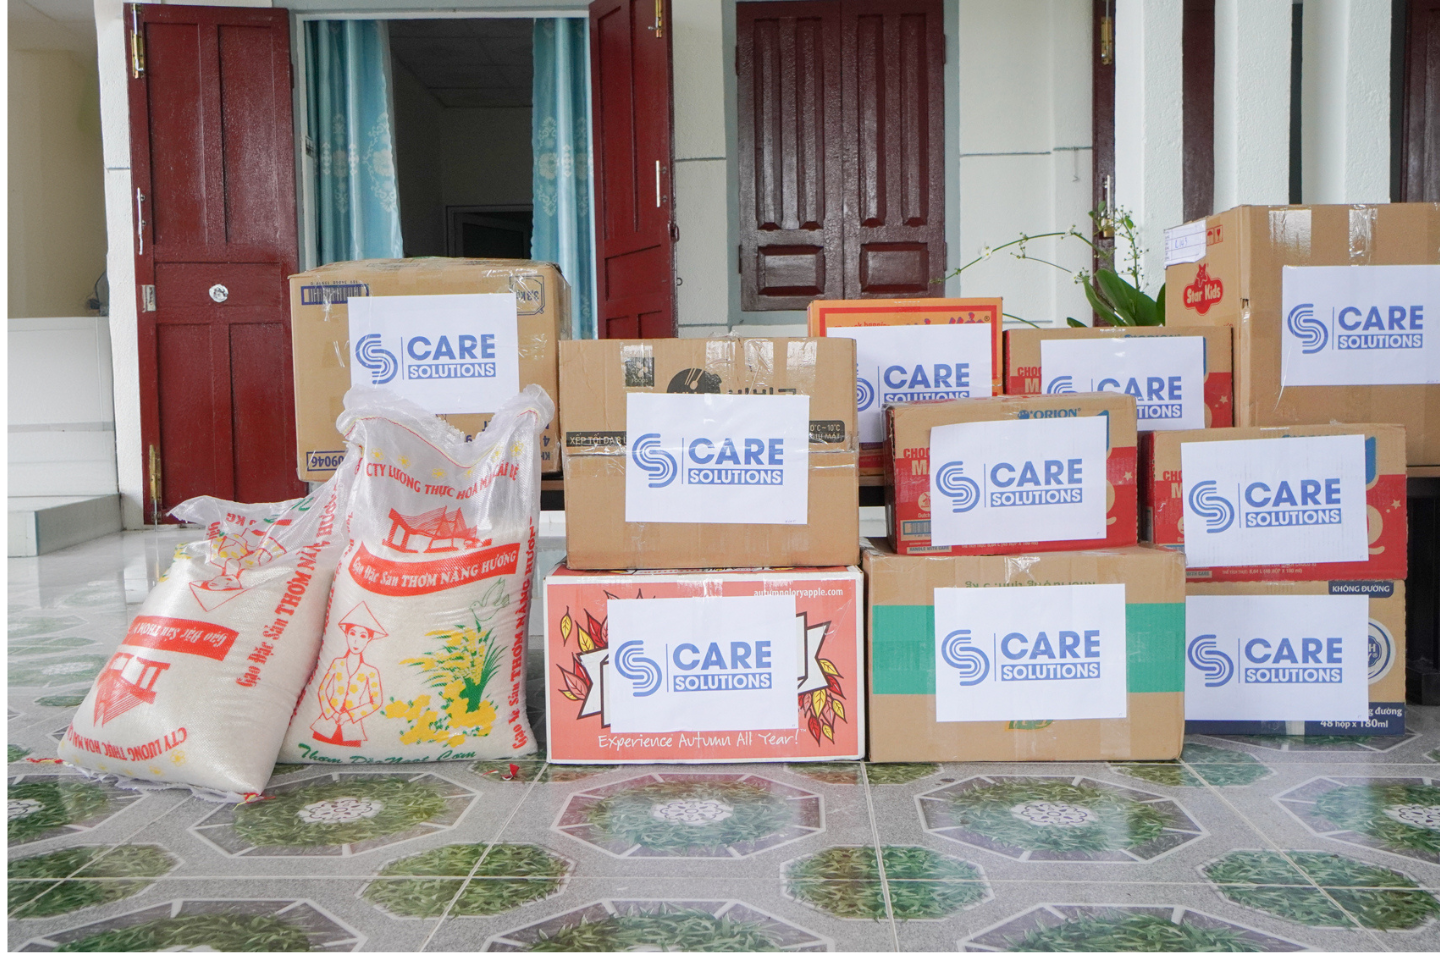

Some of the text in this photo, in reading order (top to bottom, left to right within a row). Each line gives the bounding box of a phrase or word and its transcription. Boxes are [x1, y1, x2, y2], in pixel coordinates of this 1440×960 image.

[1186, 285, 1221, 303] Star Kids
[1338, 305, 1424, 331] CARE
[407, 334, 496, 361] CARE
[1339, 334, 1423, 349] SOLUTIONS
[408, 363, 496, 380] SOLUTIONS
[883, 363, 970, 389] CARE
[885, 391, 969, 402] SOLUTIONS
[1097, 376, 1182, 401] CARE
[1034, 409, 1077, 419] ORION
[688, 438, 784, 465] CARE
[366, 462, 478, 499] CTY LƯƠNG THỰC HOA
[689, 469, 783, 485] SOLUTIONS
[990, 459, 1083, 488] CARE
[991, 489, 1082, 507] SOLUTIONS
[1244, 478, 1341, 508] CARE
[1247, 510, 1341, 527] SOLUTIONS
[401, 570, 437, 588] THƠM
[481, 549, 516, 571] HƯƠNG
[274, 570, 312, 616] THƠM
[1332, 584, 1360, 593] KHÔNG
[673, 640, 771, 670] CARE
[1001, 630, 1100, 660] CARE
[1244, 637, 1342, 664] CARE
[510, 628, 524, 683] THƠM
[1002, 662, 1100, 680] SOLUTIONS
[1246, 669, 1342, 683] SOLUTIONS
[674, 673, 772, 691] SOLUTIONS
[1375, 706, 1402, 717] đường
[1321, 720, 1333, 728] 48
[165, 727, 188, 752] CTY
[597, 733, 673, 751] Experience
[678, 731, 731, 748] Autumn
[736, 731, 753, 747] All
[102, 741, 128, 761] THỰC
